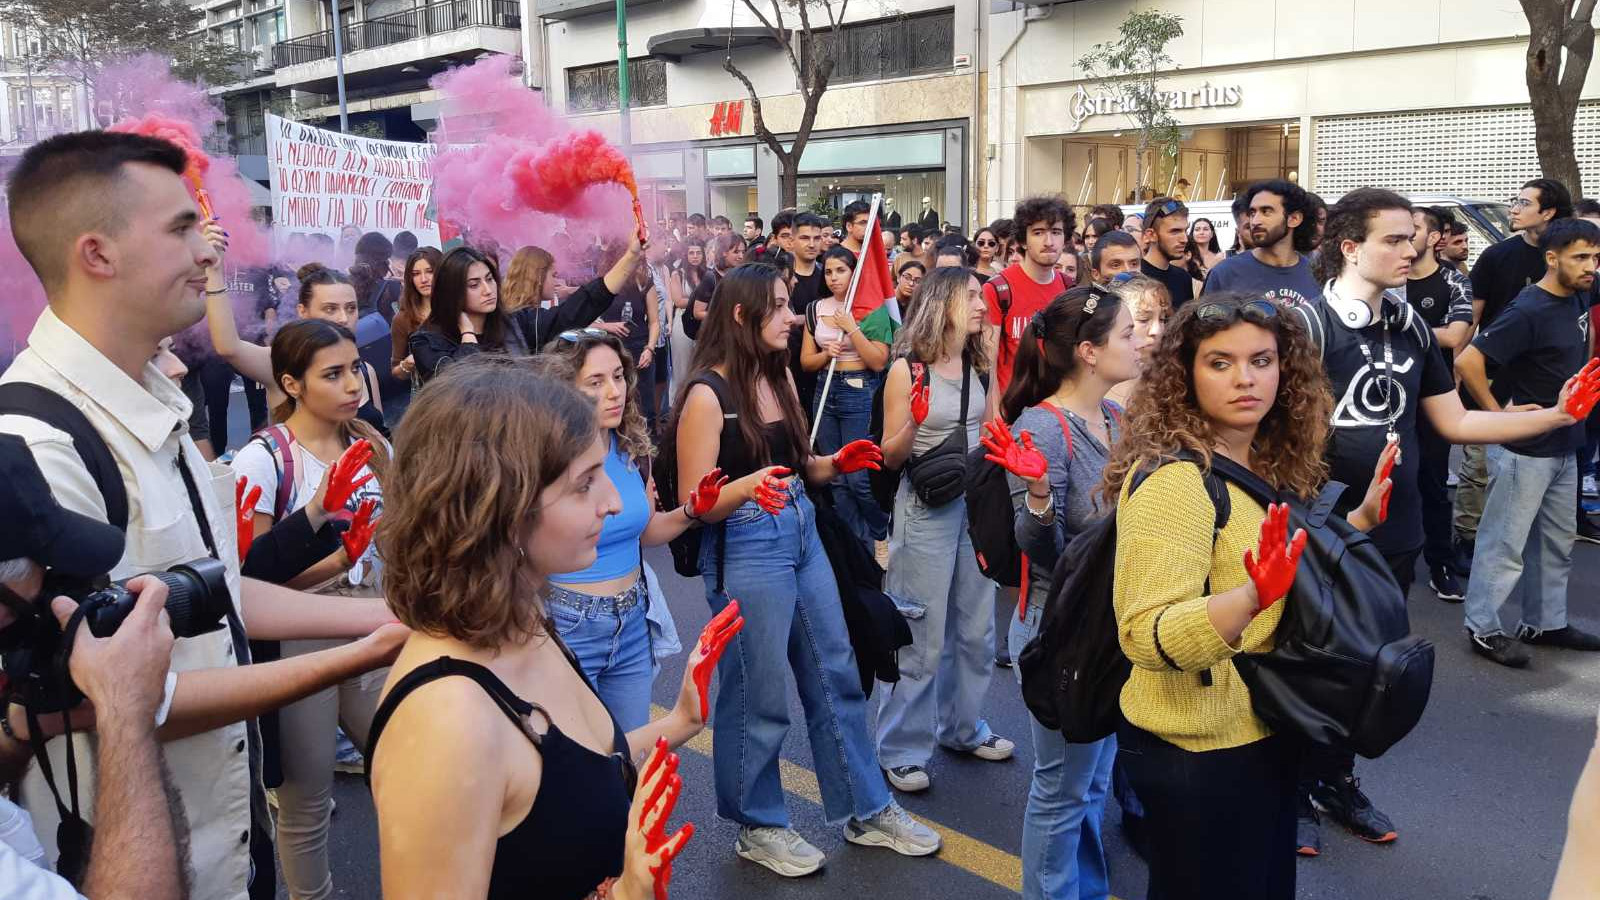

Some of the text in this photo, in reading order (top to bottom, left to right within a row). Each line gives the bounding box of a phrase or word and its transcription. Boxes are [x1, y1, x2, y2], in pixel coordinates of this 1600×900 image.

[1085, 82, 1242, 116] stravarius
[288, 142, 337, 168] ΝΕΟΛΑΙΑ
[342, 151, 368, 174] ΔΕΝ
